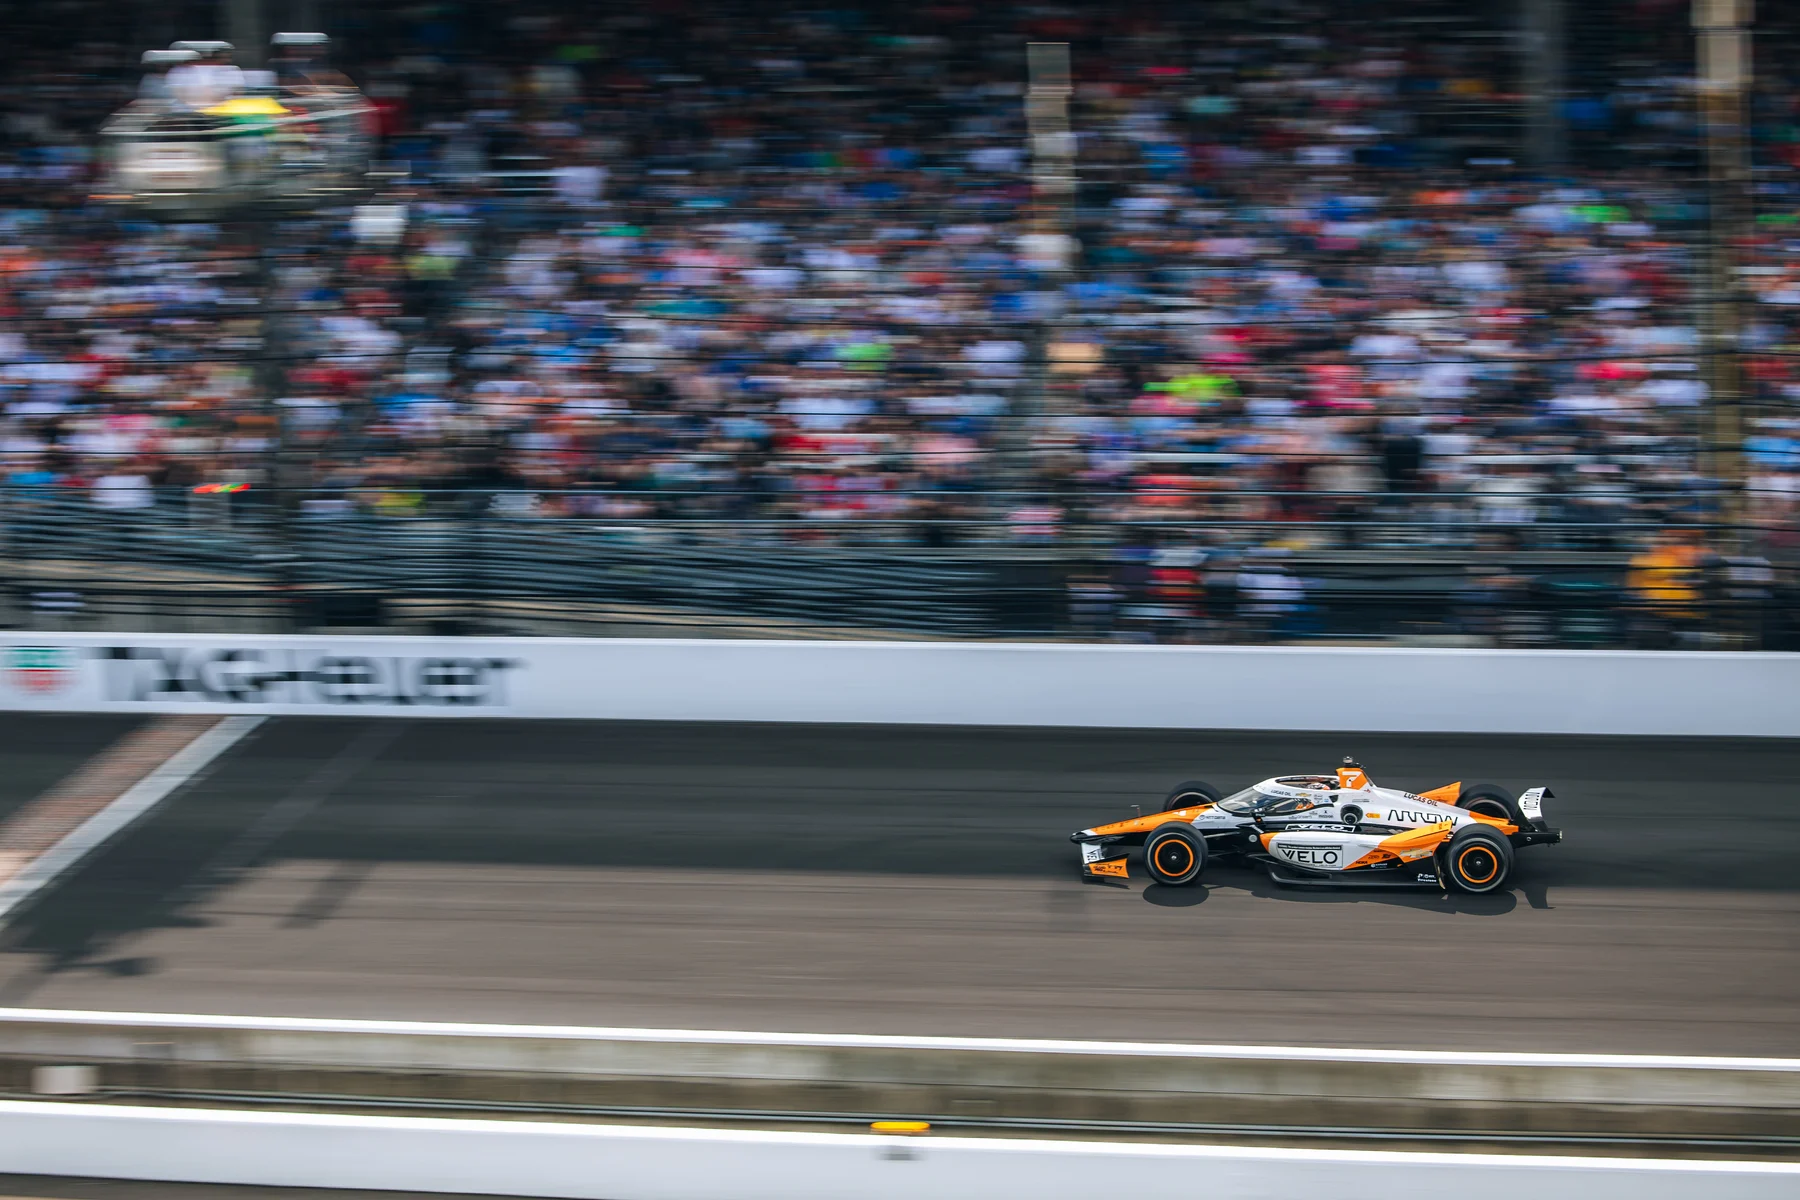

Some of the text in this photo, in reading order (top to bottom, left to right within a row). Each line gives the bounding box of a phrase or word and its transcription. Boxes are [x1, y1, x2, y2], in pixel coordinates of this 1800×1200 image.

[1342, 771, 1362, 788] 7
[1403, 792, 1438, 807] LUCAS OIL
[1388, 809, 1458, 826] ARROW
[1281, 849, 1338, 864] VELO
